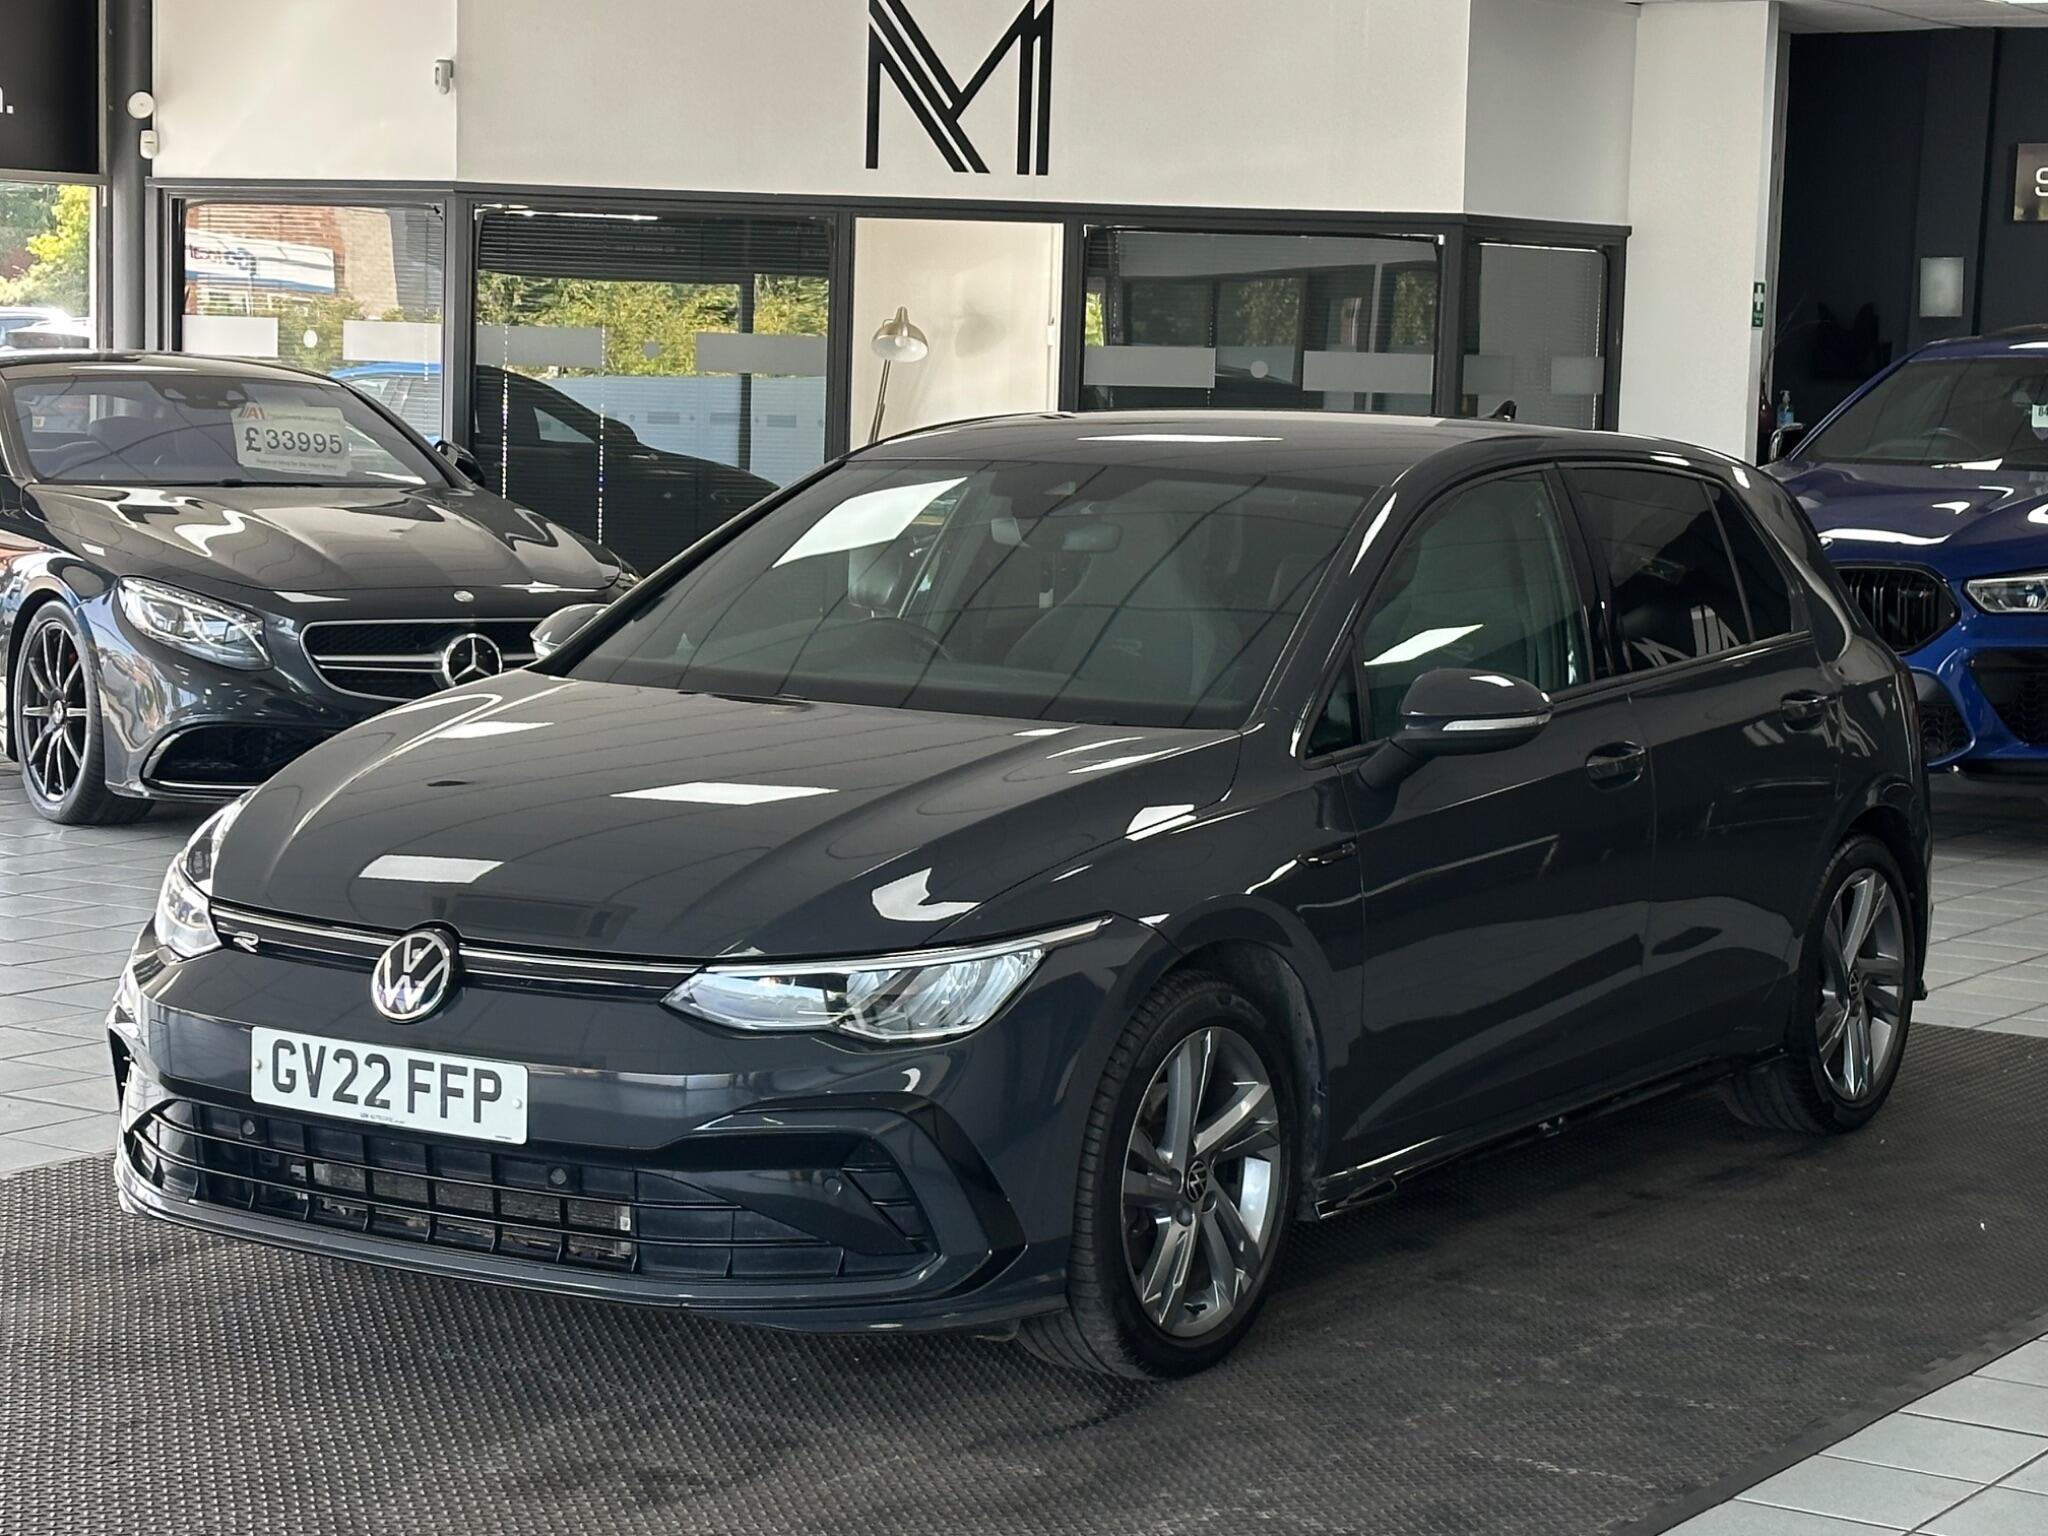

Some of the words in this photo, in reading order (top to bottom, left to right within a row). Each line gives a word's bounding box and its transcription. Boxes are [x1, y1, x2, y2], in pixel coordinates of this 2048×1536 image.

[245, 427, 342, 454] £33995
[272, 1038, 391, 1110] GV22
[408, 1058, 502, 1124] FFP
